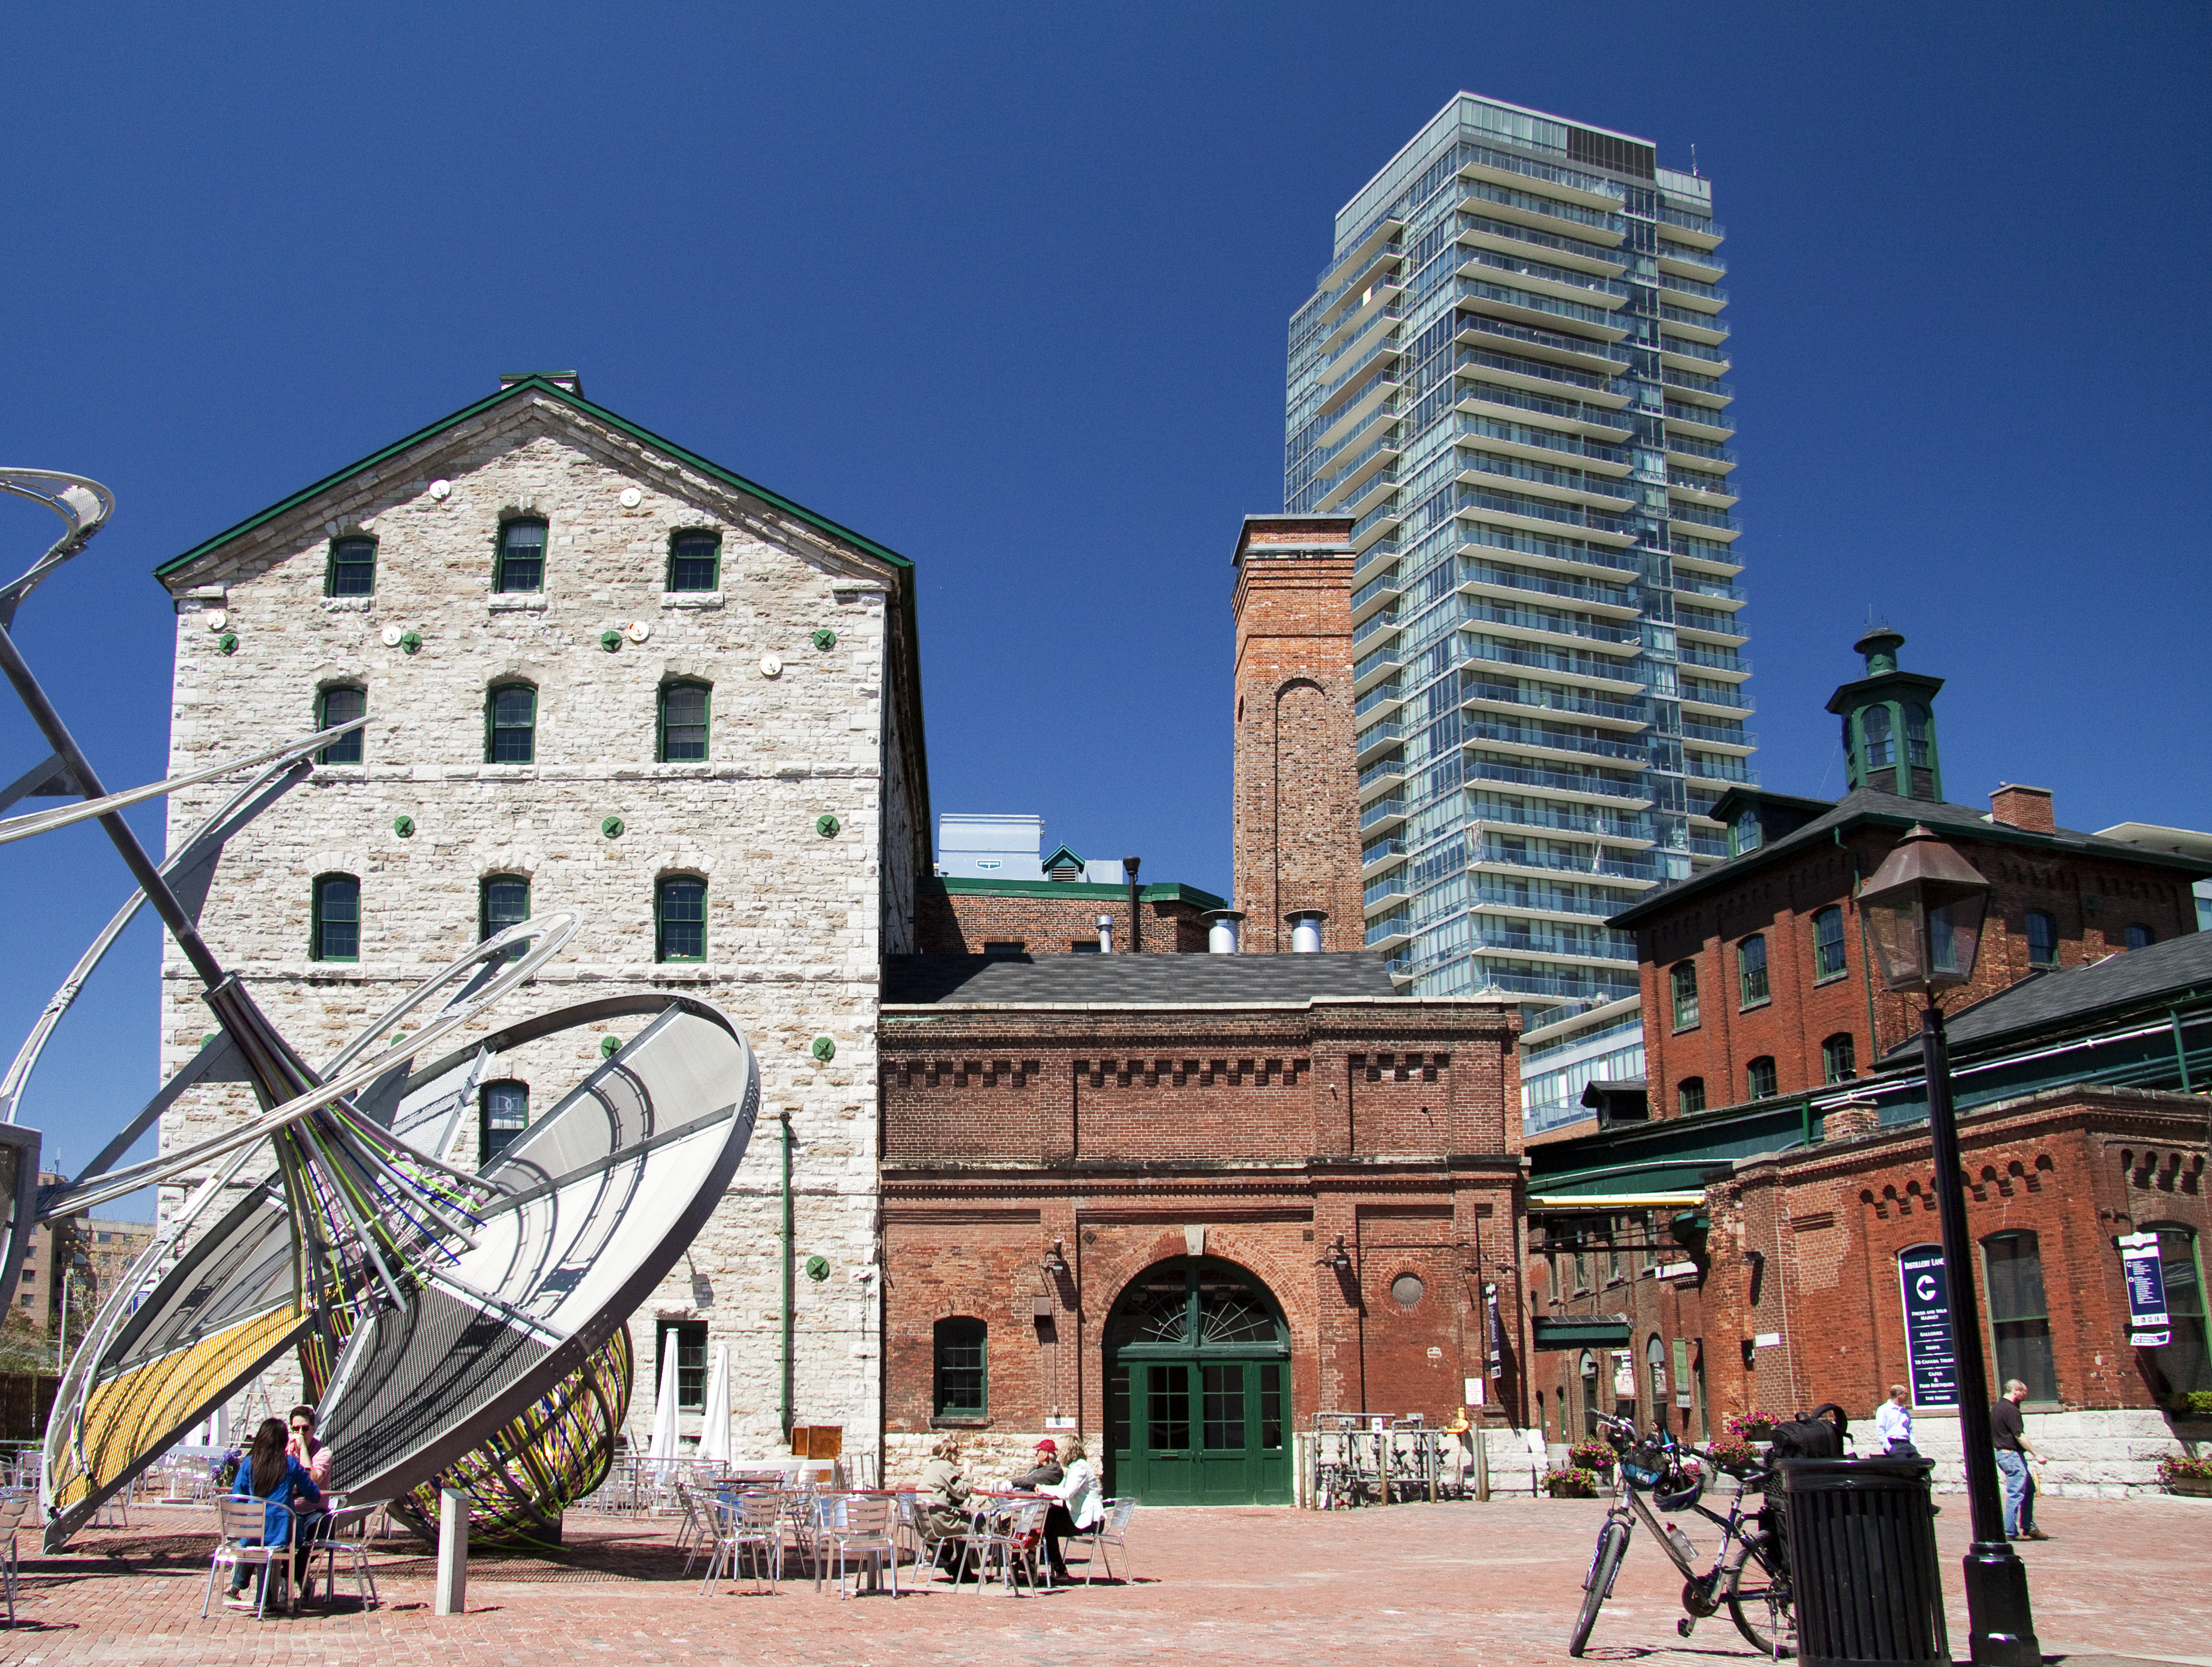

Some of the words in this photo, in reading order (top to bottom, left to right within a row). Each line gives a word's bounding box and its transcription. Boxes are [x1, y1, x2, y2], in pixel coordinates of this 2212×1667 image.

[2124, 1235, 2151, 1244] DISTILLERY
[1904, 1260, 1931, 1270] DISTILLERY
[1931, 1258, 1946, 1266] LANE
